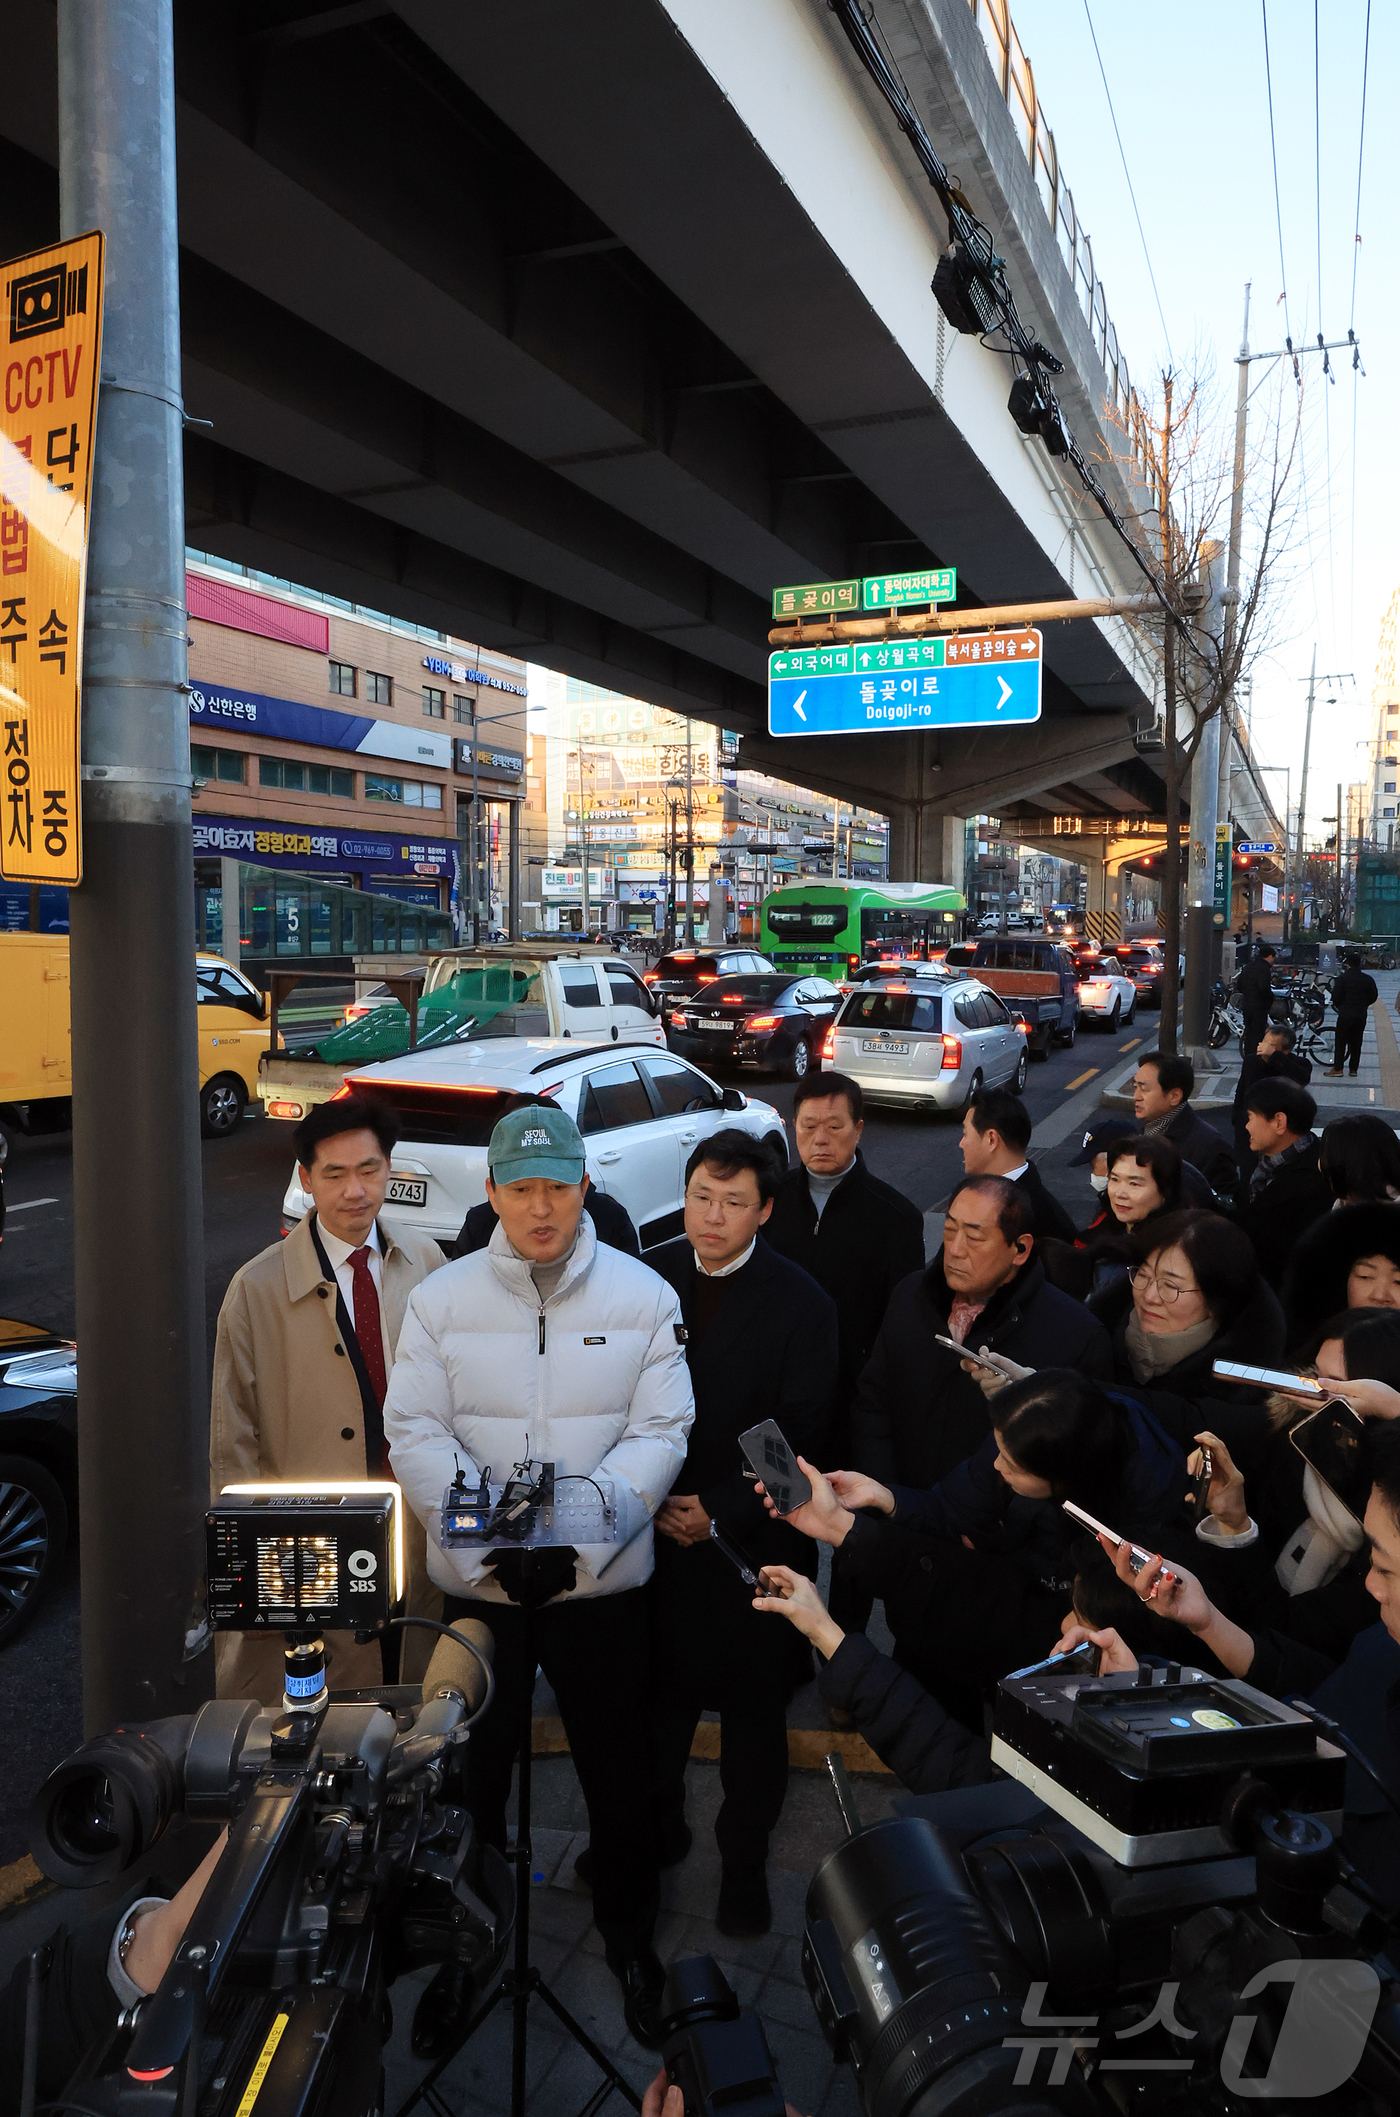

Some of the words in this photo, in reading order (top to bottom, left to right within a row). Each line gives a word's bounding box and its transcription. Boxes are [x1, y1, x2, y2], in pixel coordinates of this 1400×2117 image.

[5, 344, 82, 414] CCTV
[883, 573, 951, 594] 동덕여자대학교
[884, 594, 904, 603] Dongduk
[905, 591, 926, 600] Women's
[928, 588, 951, 597] University
[876, 645, 936, 666] 상월곡역
[947, 639, 1018, 660] 북서울꿈의숲
[427, 656, 451, 676] YBM
[790, 652, 849, 672] 외국어대
[859, 676, 940, 704] 돌곶이로
[208, 696, 257, 721] 신한은행
[866, 703, 932, 721] Dolgoji-ro
[1217, 843, 1224, 853] 4
[545, 872, 566, 885] 진로
[287, 907, 299, 932] 5
[812, 914, 834, 926] 1222
[715, 1021, 731, 1029] 9819
[884, 1043, 905, 1053] 9493
[524, 1129, 547, 1139] SEOUL
[533, 1137, 552, 1146] SOUL
[390, 1182, 422, 1201] 6743
[349, 1580, 377, 1593] SBS
